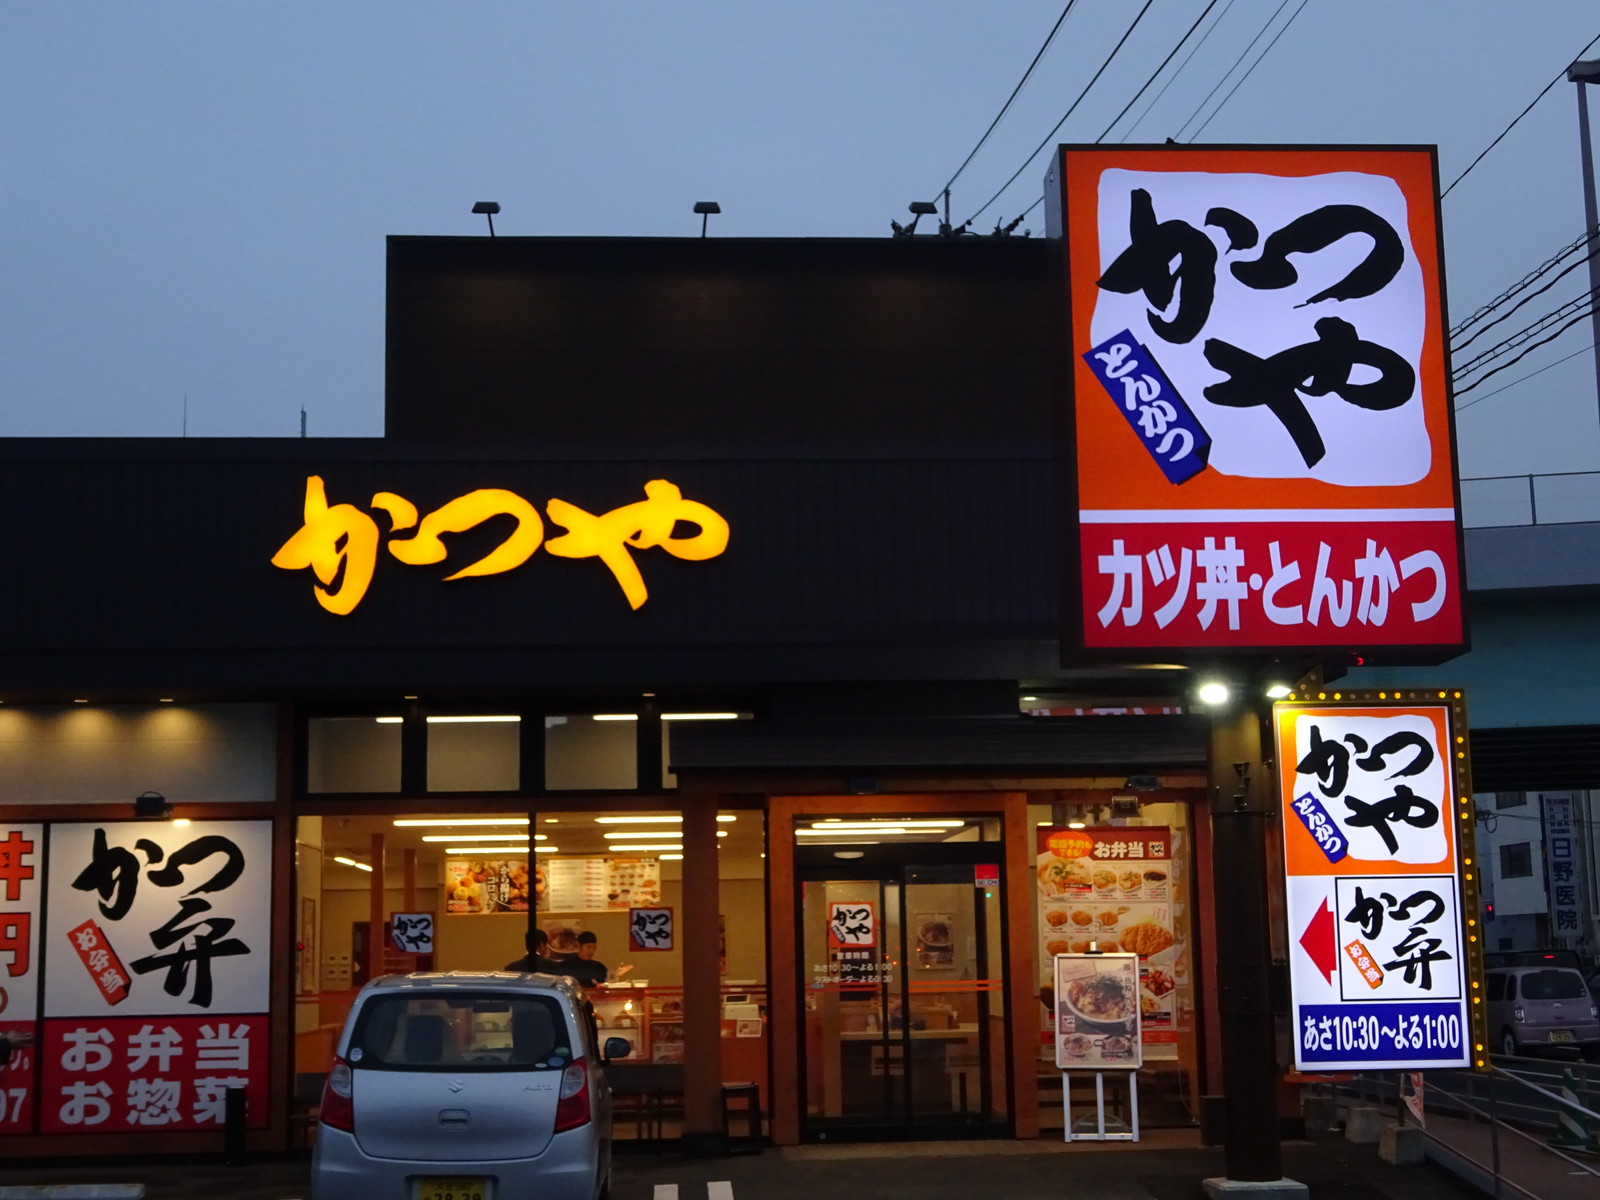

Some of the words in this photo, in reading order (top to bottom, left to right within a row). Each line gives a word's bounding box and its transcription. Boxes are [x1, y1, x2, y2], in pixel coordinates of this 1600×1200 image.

[1095, 343, 1194, 461] とんかつ
[271, 475, 730, 615] かつや
[1097, 536, 1447, 631] カツ丼・とんかつ
[1094, 841, 1144, 858] お弁当
[1295, 798, 1341, 853] とんかつ
[1552, 838, 1578, 931] 日野医院
[75, 928, 124, 993] お弁当
[836, 951, 869, 960] 営業時間
[61, 1023, 250, 1072] お弁当
